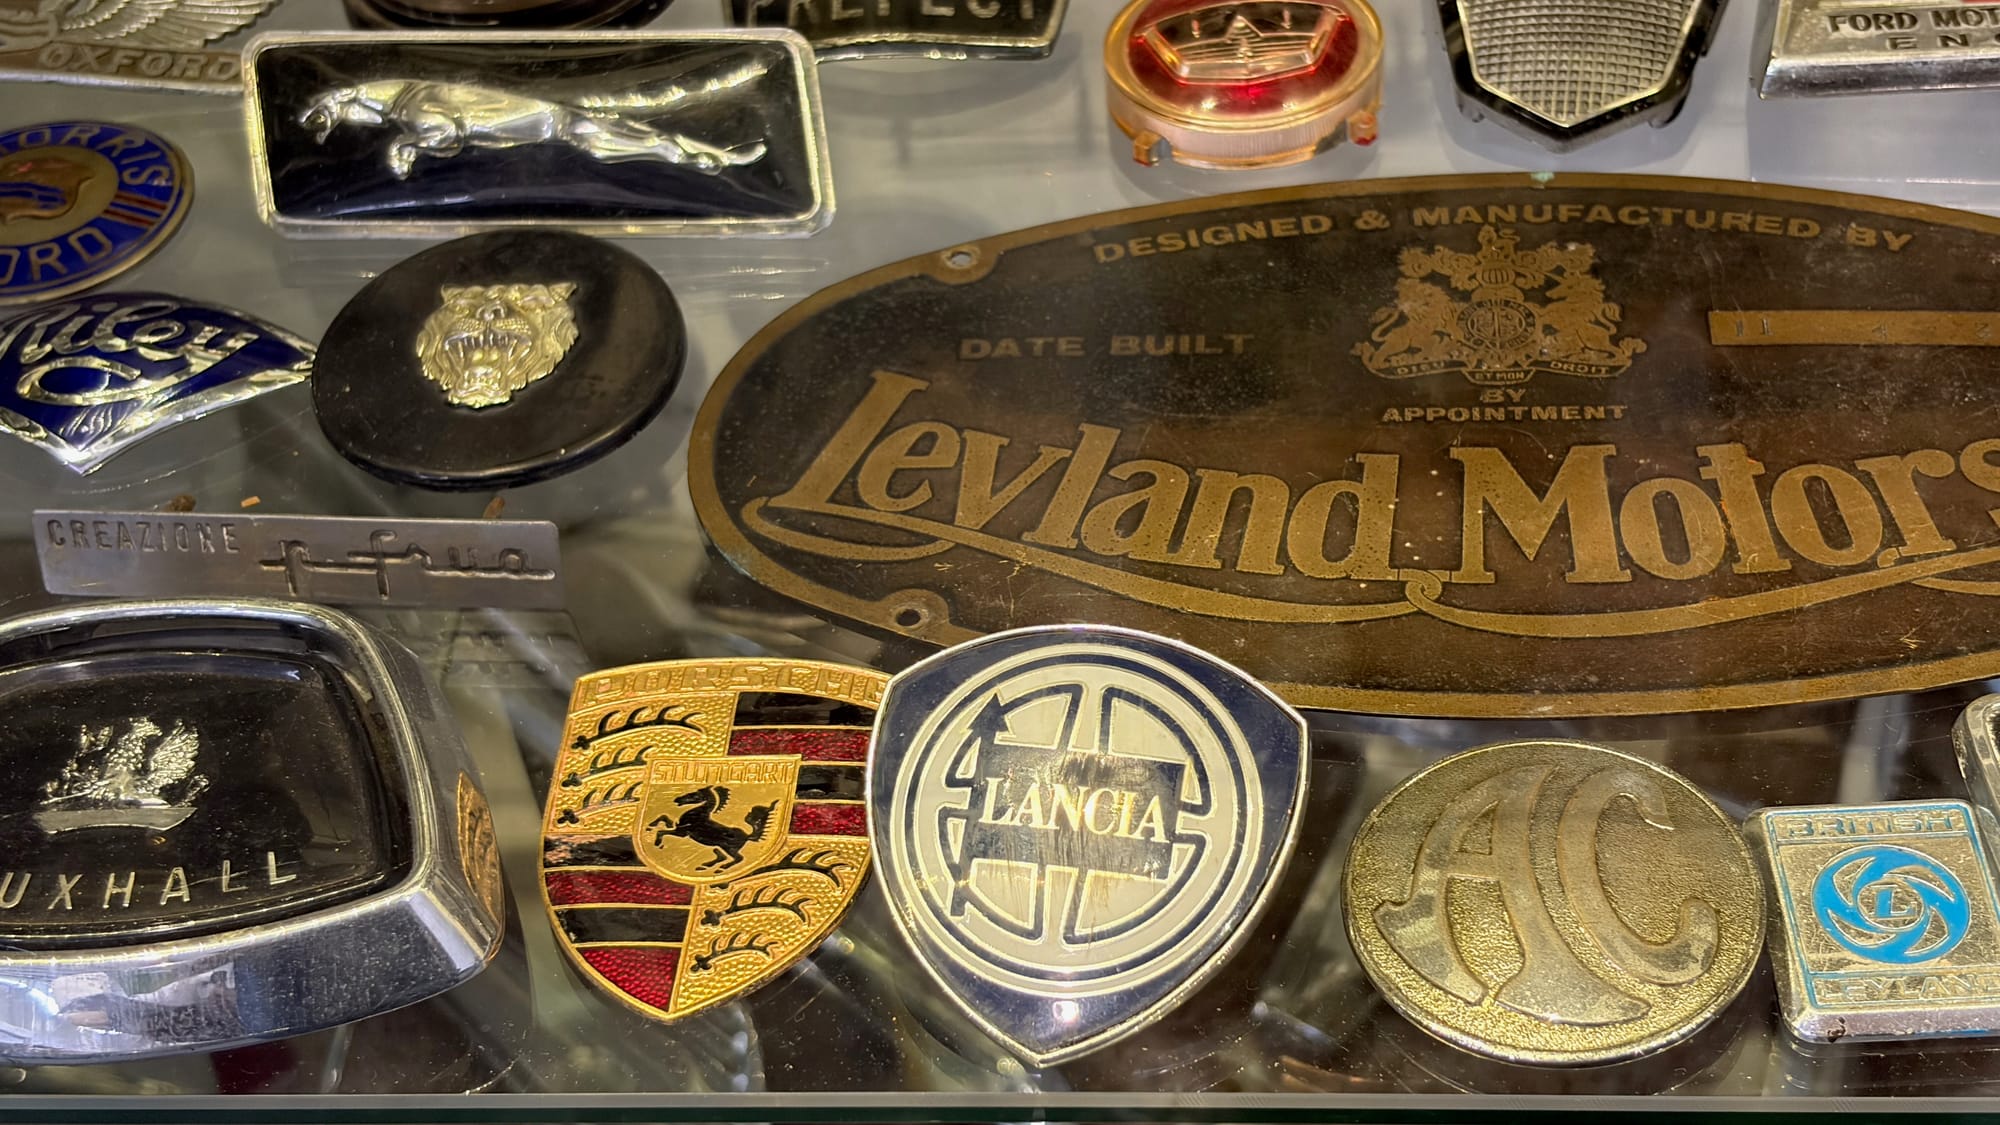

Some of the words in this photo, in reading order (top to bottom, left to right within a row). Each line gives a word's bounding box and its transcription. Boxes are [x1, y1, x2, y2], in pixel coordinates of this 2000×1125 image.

[1828, 12, 1918, 33] FORD
[1888, 34, 2000, 51] EN
[40, 44, 240, 80] OXFORD
[0, 128, 172, 186] ORRIS
[1094, 213, 1334, 264] DESIGNED
[1355, 210, 1390, 230] &
[1413, 204, 1820, 239] MANUFACTURED
[1846, 222, 1912, 252] BY
[958, 337, 1085, 361] DATE
[1110, 333, 1254, 357] BUILT
[1480, 388, 1526, 403] BY
[1382, 405, 1628, 423] APPOINTMENT
[742, 370, 1404, 592] Leyland
[47, 519, 240, 553] CREAZIONE
[653, 760, 795, 784] STUTTGART
[977, 776, 1171, 844] LANCIA
[1788, 813, 1954, 837] BRITISH
[1373, 763, 1720, 1027] AC
